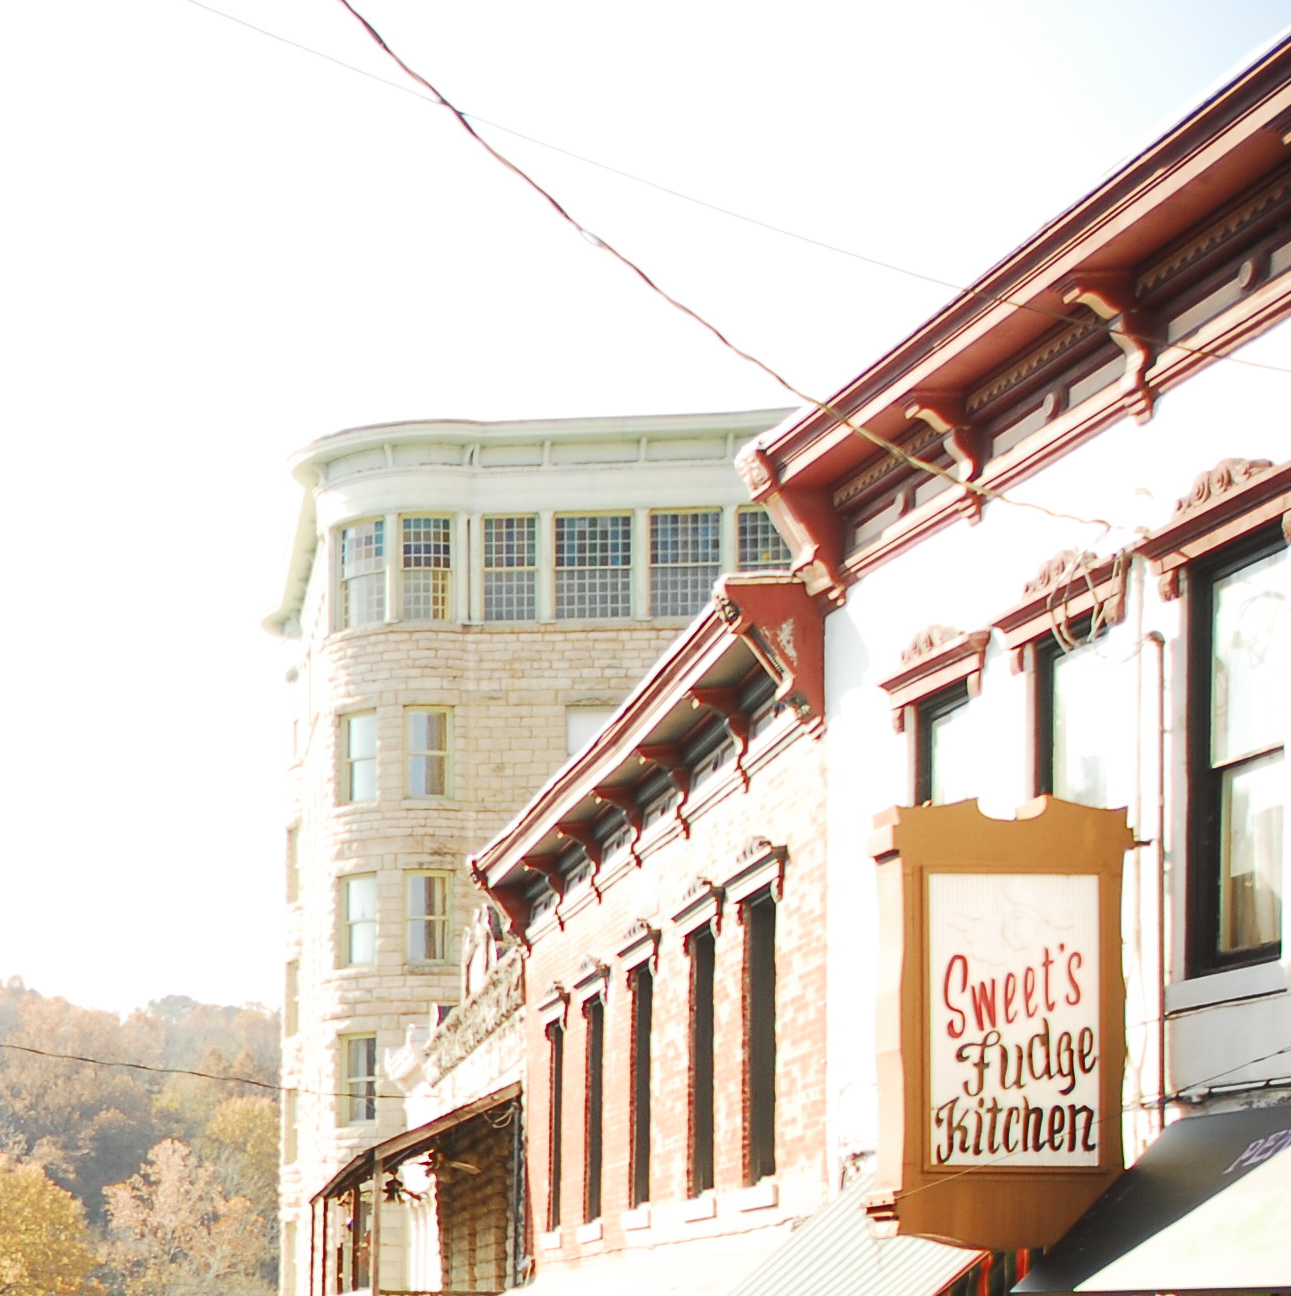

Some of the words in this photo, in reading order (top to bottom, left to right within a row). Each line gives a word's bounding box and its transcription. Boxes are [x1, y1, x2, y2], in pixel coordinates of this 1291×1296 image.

[943, 943, 1083, 1038] Sweet's
[956, 1019, 1097, 1097] Fudge
[935, 1096, 1096, 1164] Kitchen
